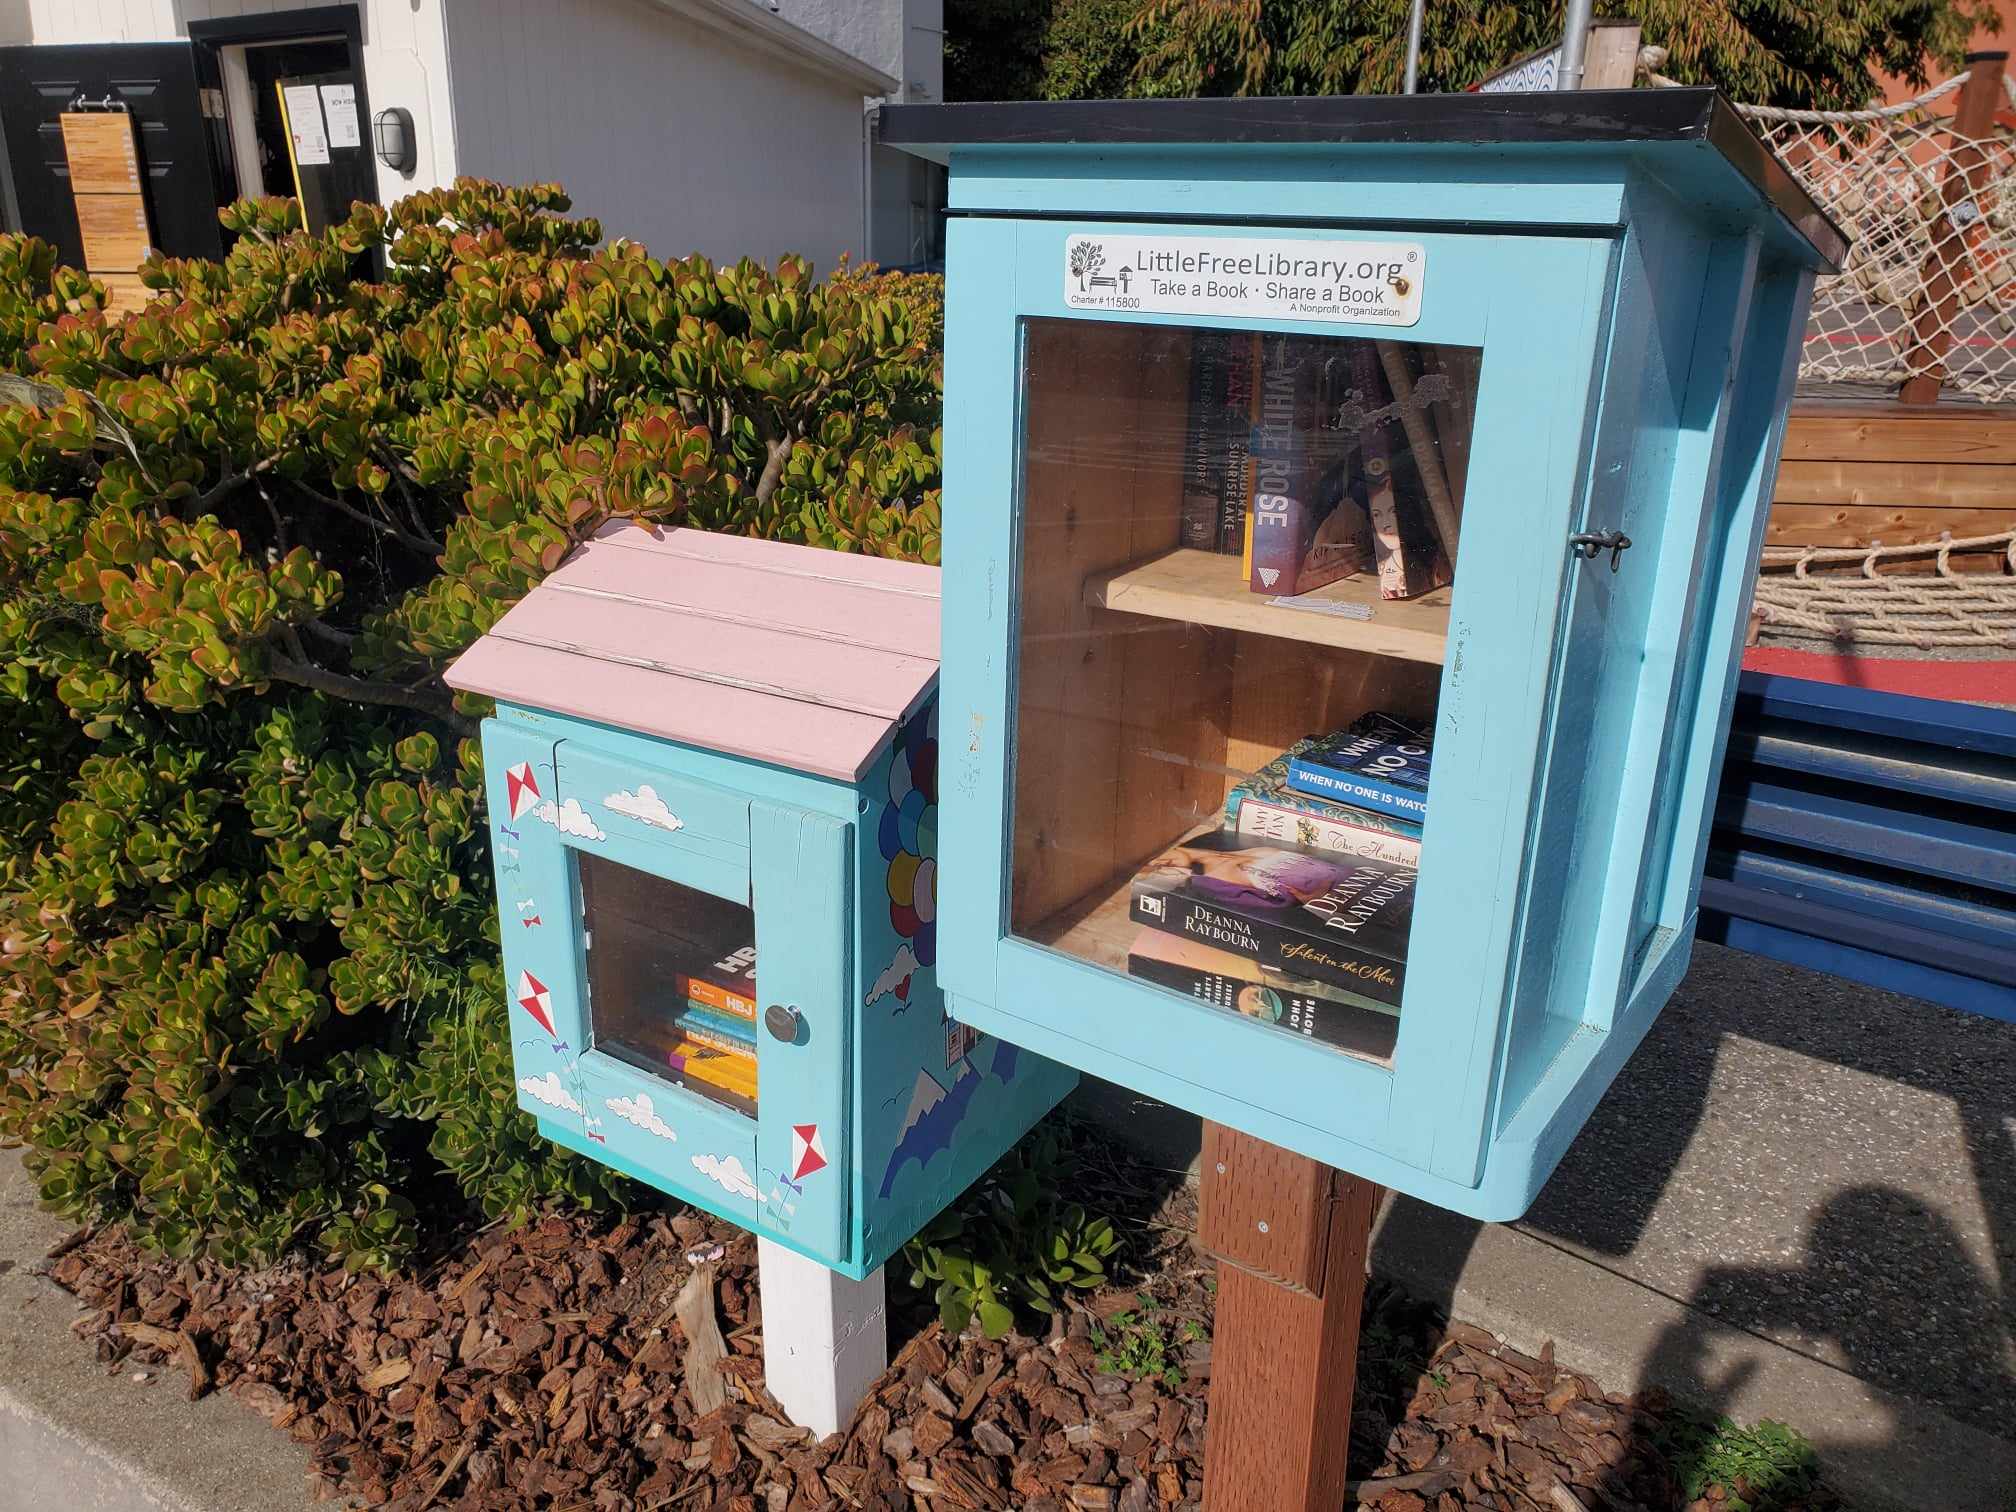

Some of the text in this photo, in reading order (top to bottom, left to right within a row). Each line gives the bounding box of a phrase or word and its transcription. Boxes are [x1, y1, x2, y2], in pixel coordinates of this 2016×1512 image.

[1071, 295, 1097, 304] Charter
[1105, 298, 1140, 309] 115800
[1151, 279, 1385, 304] Take a Book Share a Book
[1290, 303, 1400, 317] A Nonprofit Organization
[1257, 369, 1296, 528] WHITE ROSE
[1224, 442, 1240, 530] SUNRISE LAKE
[1360, 755, 1407, 776] NO
[1299, 770, 1332, 787] WHEN
[1334, 781, 1353, 793] NO
[1354, 786, 1380, 800] ONE
[1381, 792, 1393, 804] IS
[1251, 808, 1268, 837] AMY
[1327, 830, 1417, 867] The Hundred
[1302, 866, 1384, 914] DEANNA
[1324, 869, 1417, 934] RAYBOURN
[1185, 916, 1260, 951] RAYBOURN
[1194, 905, 1252, 936] DEANNA
[1280, 942, 1328, 964] Silent
[1338, 960, 1358, 974] the
[1194, 982, 1202, 997] THE
[1290, 999, 1301, 1028] JOHN
[1303, 999, 1316, 1036] BOYNE
